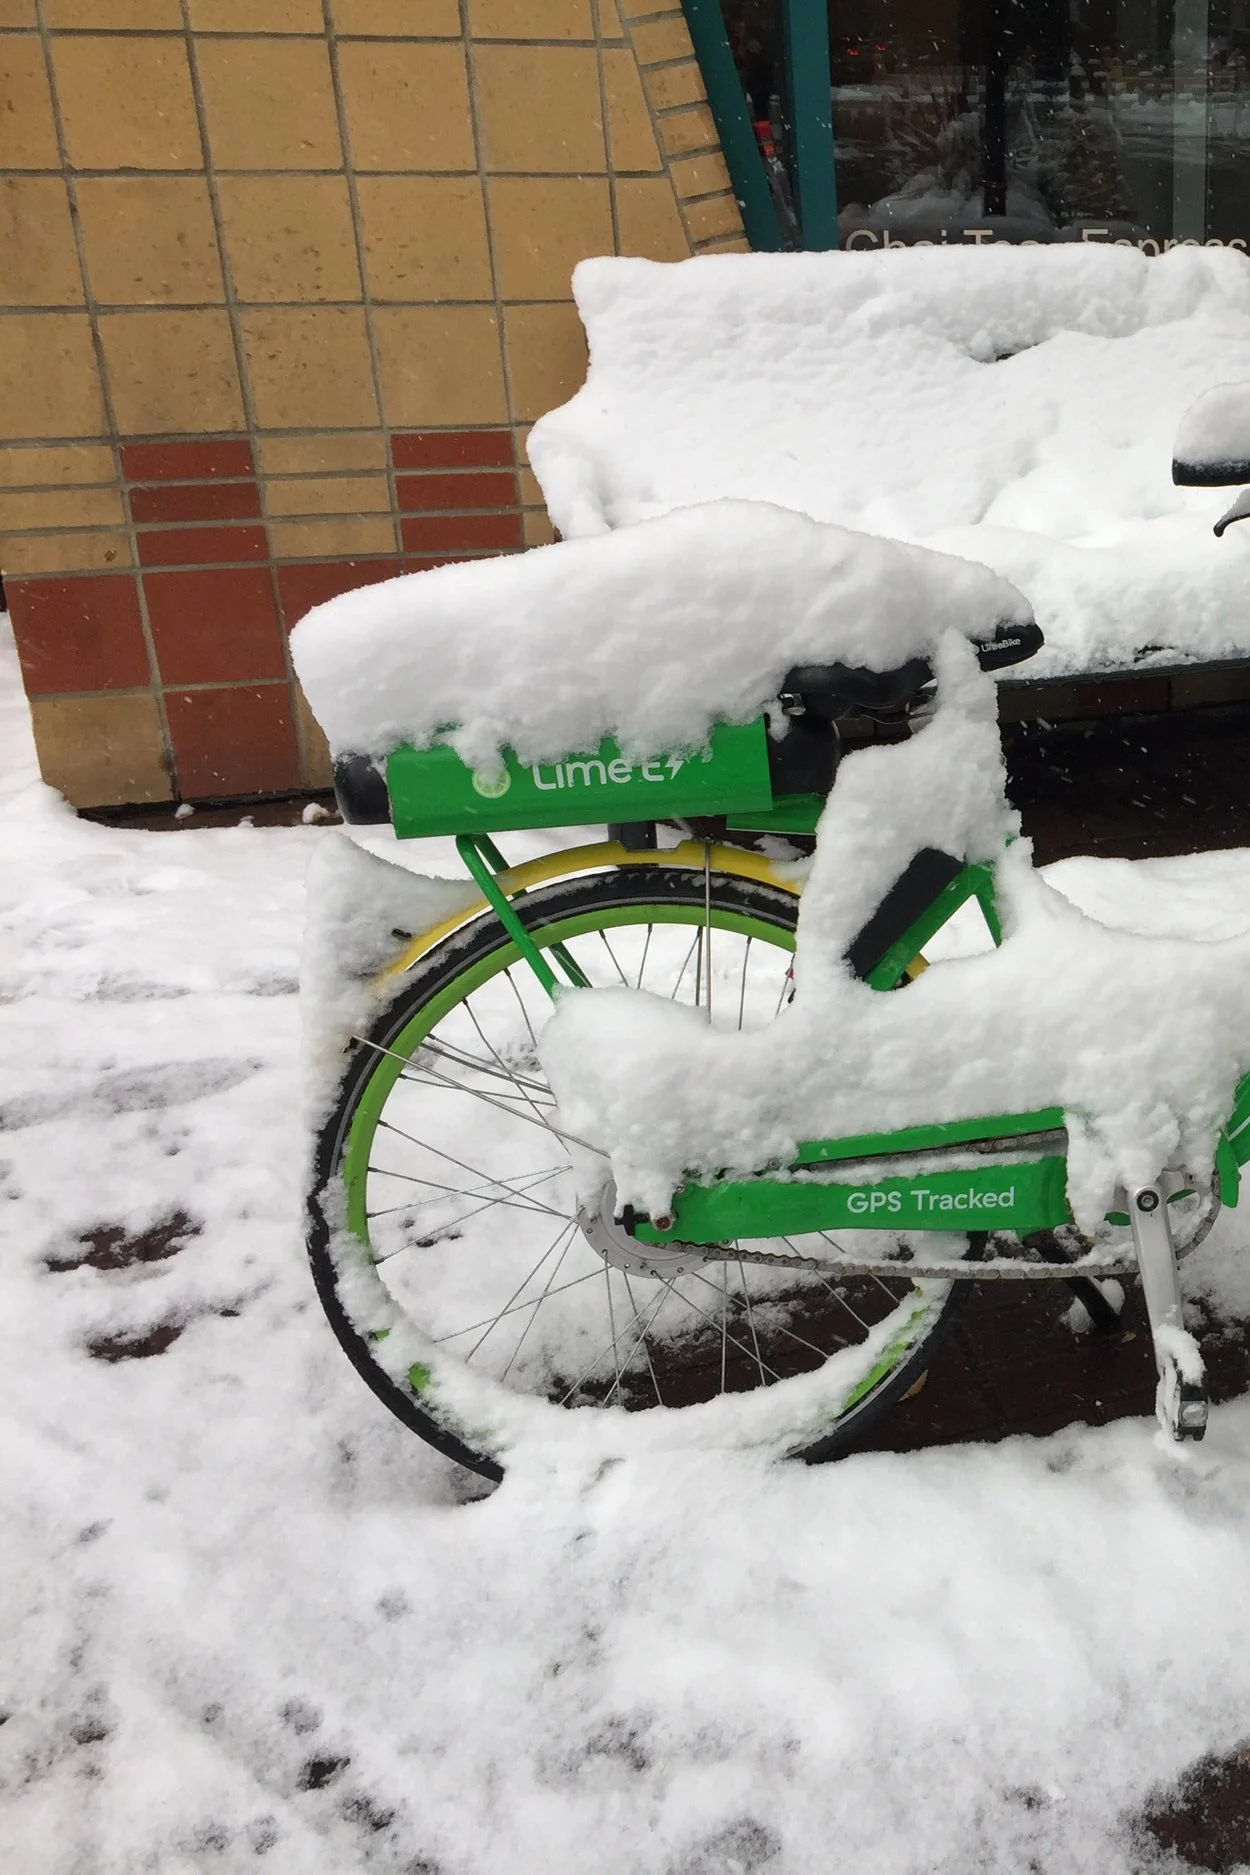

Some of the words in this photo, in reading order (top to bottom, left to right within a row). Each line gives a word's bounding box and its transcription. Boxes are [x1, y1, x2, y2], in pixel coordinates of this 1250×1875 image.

[845, 229, 947, 250] Ch
[532, 758, 633, 790] Lime
[847, 1191, 902, 1213] GPS
[910, 1186, 1015, 1211] Tracked
